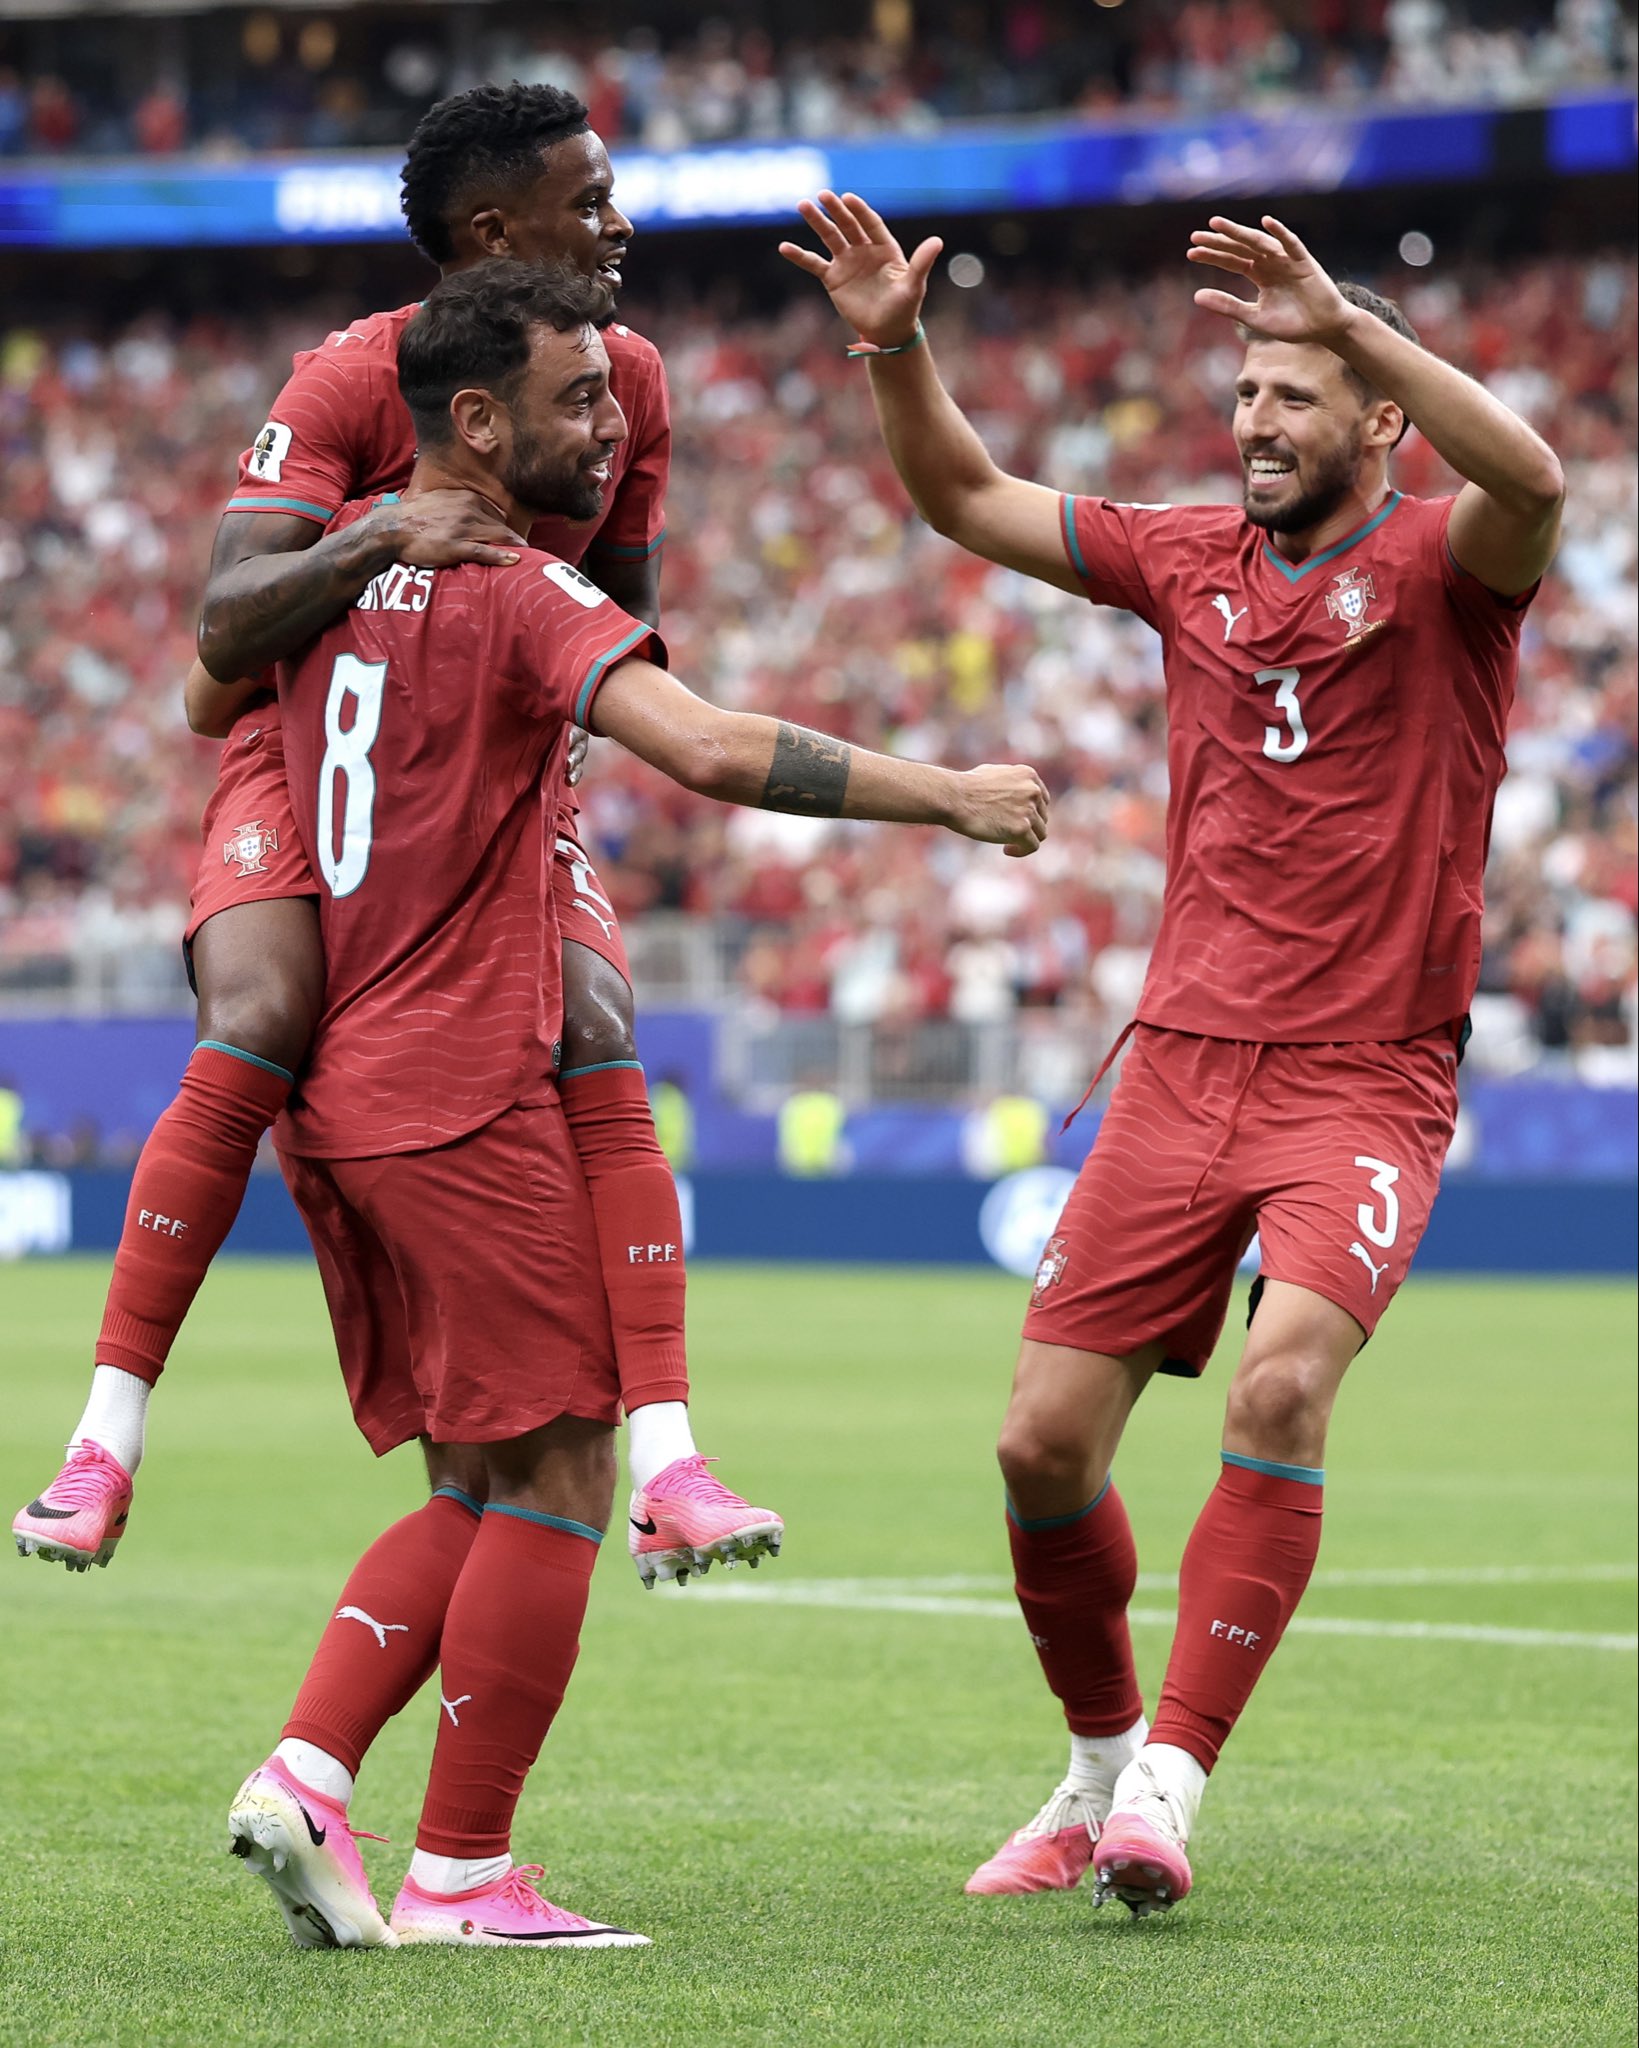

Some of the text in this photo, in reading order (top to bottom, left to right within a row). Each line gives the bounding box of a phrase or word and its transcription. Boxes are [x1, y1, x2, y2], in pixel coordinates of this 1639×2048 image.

[1253, 666, 1309, 763] 3
[317, 652, 389, 898] 8
[1354, 1156, 1399, 1248] 3
